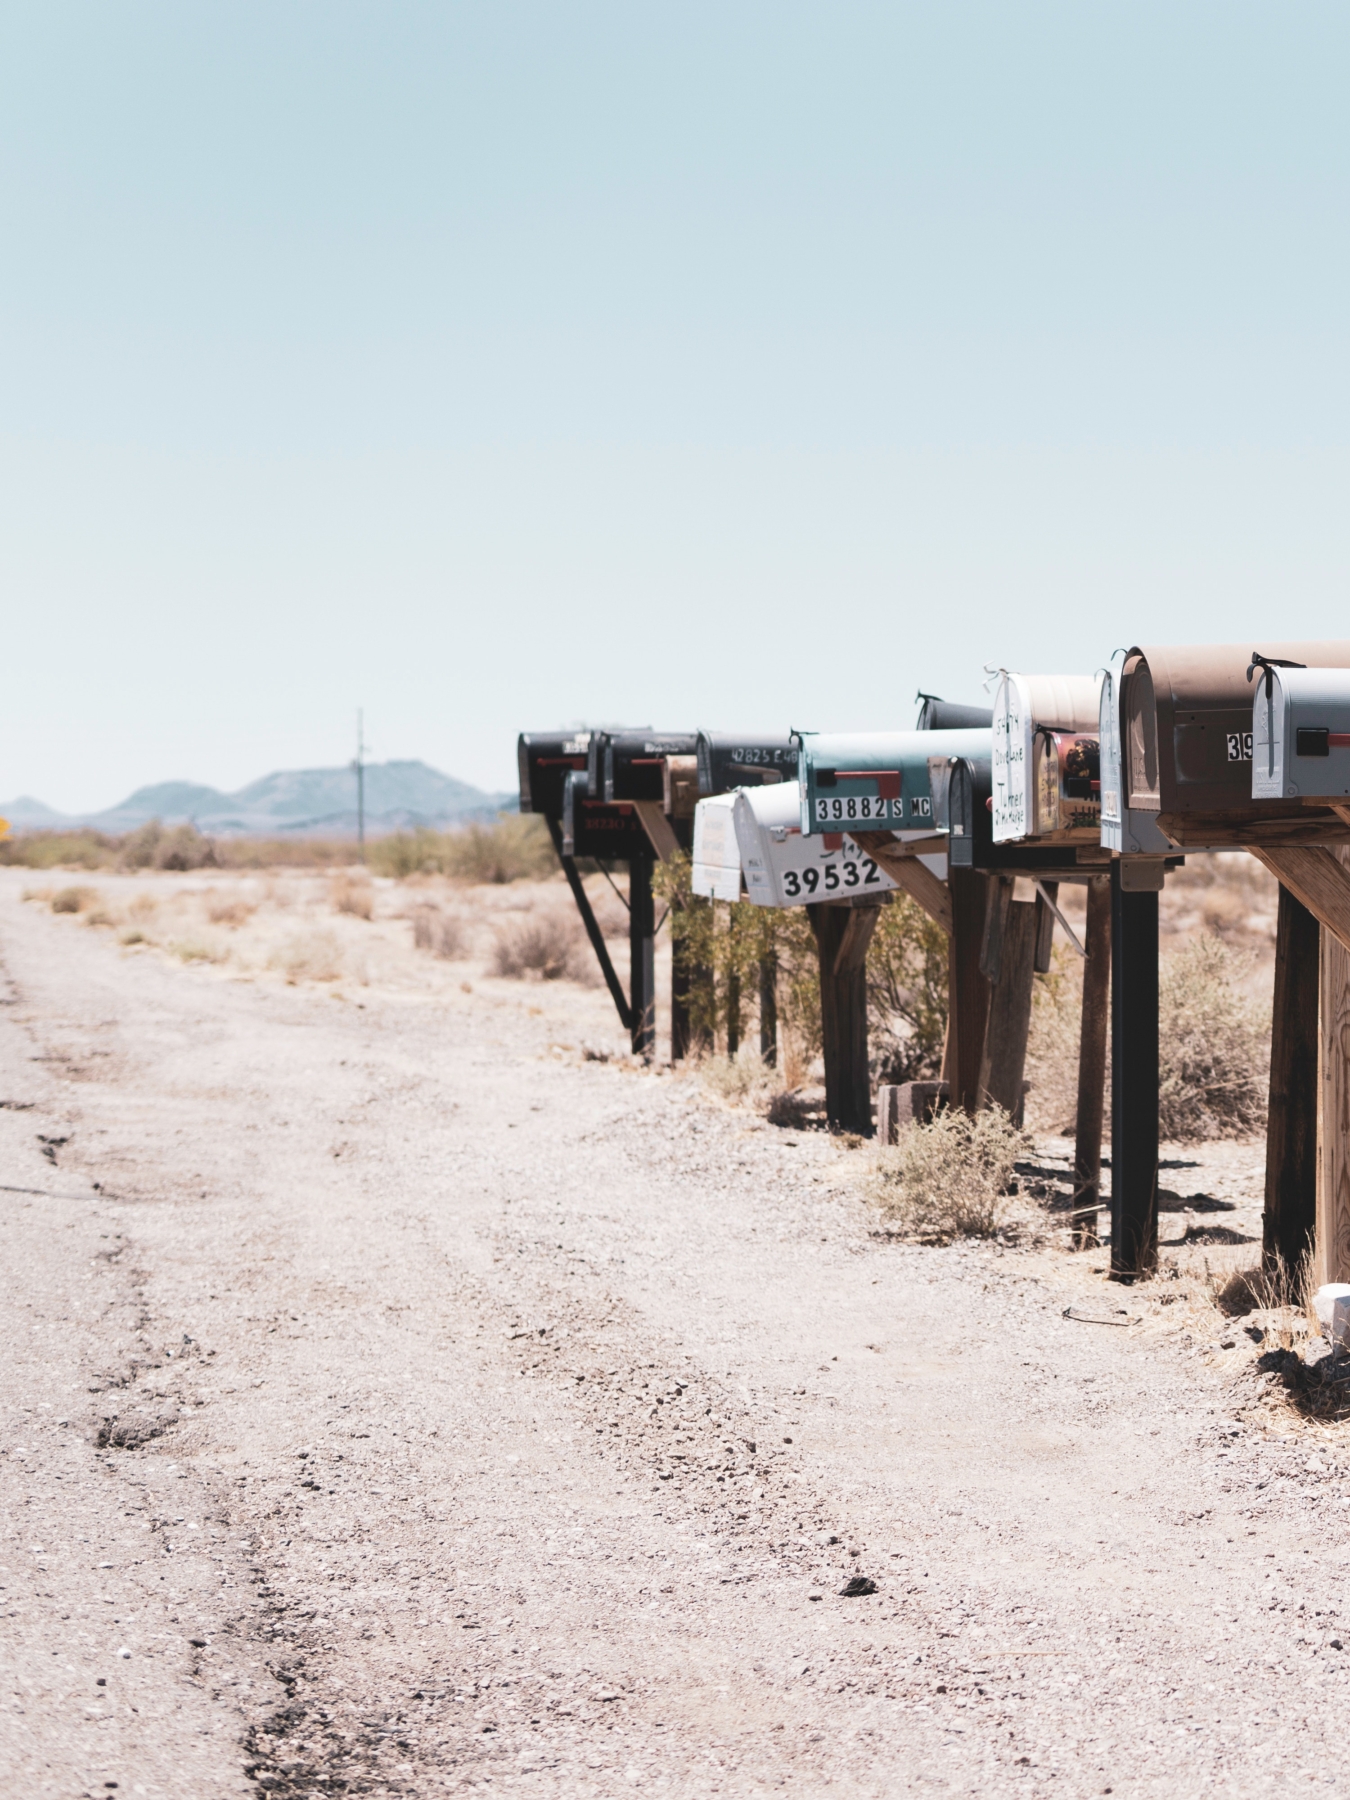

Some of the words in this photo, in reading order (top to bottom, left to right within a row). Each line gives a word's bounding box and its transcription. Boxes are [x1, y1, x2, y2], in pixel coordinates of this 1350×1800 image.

[818, 797, 886, 820] 39882
[893, 799, 903, 817] S
[911, 799, 930, 817] MC
[784, 859, 880, 896] 39532
